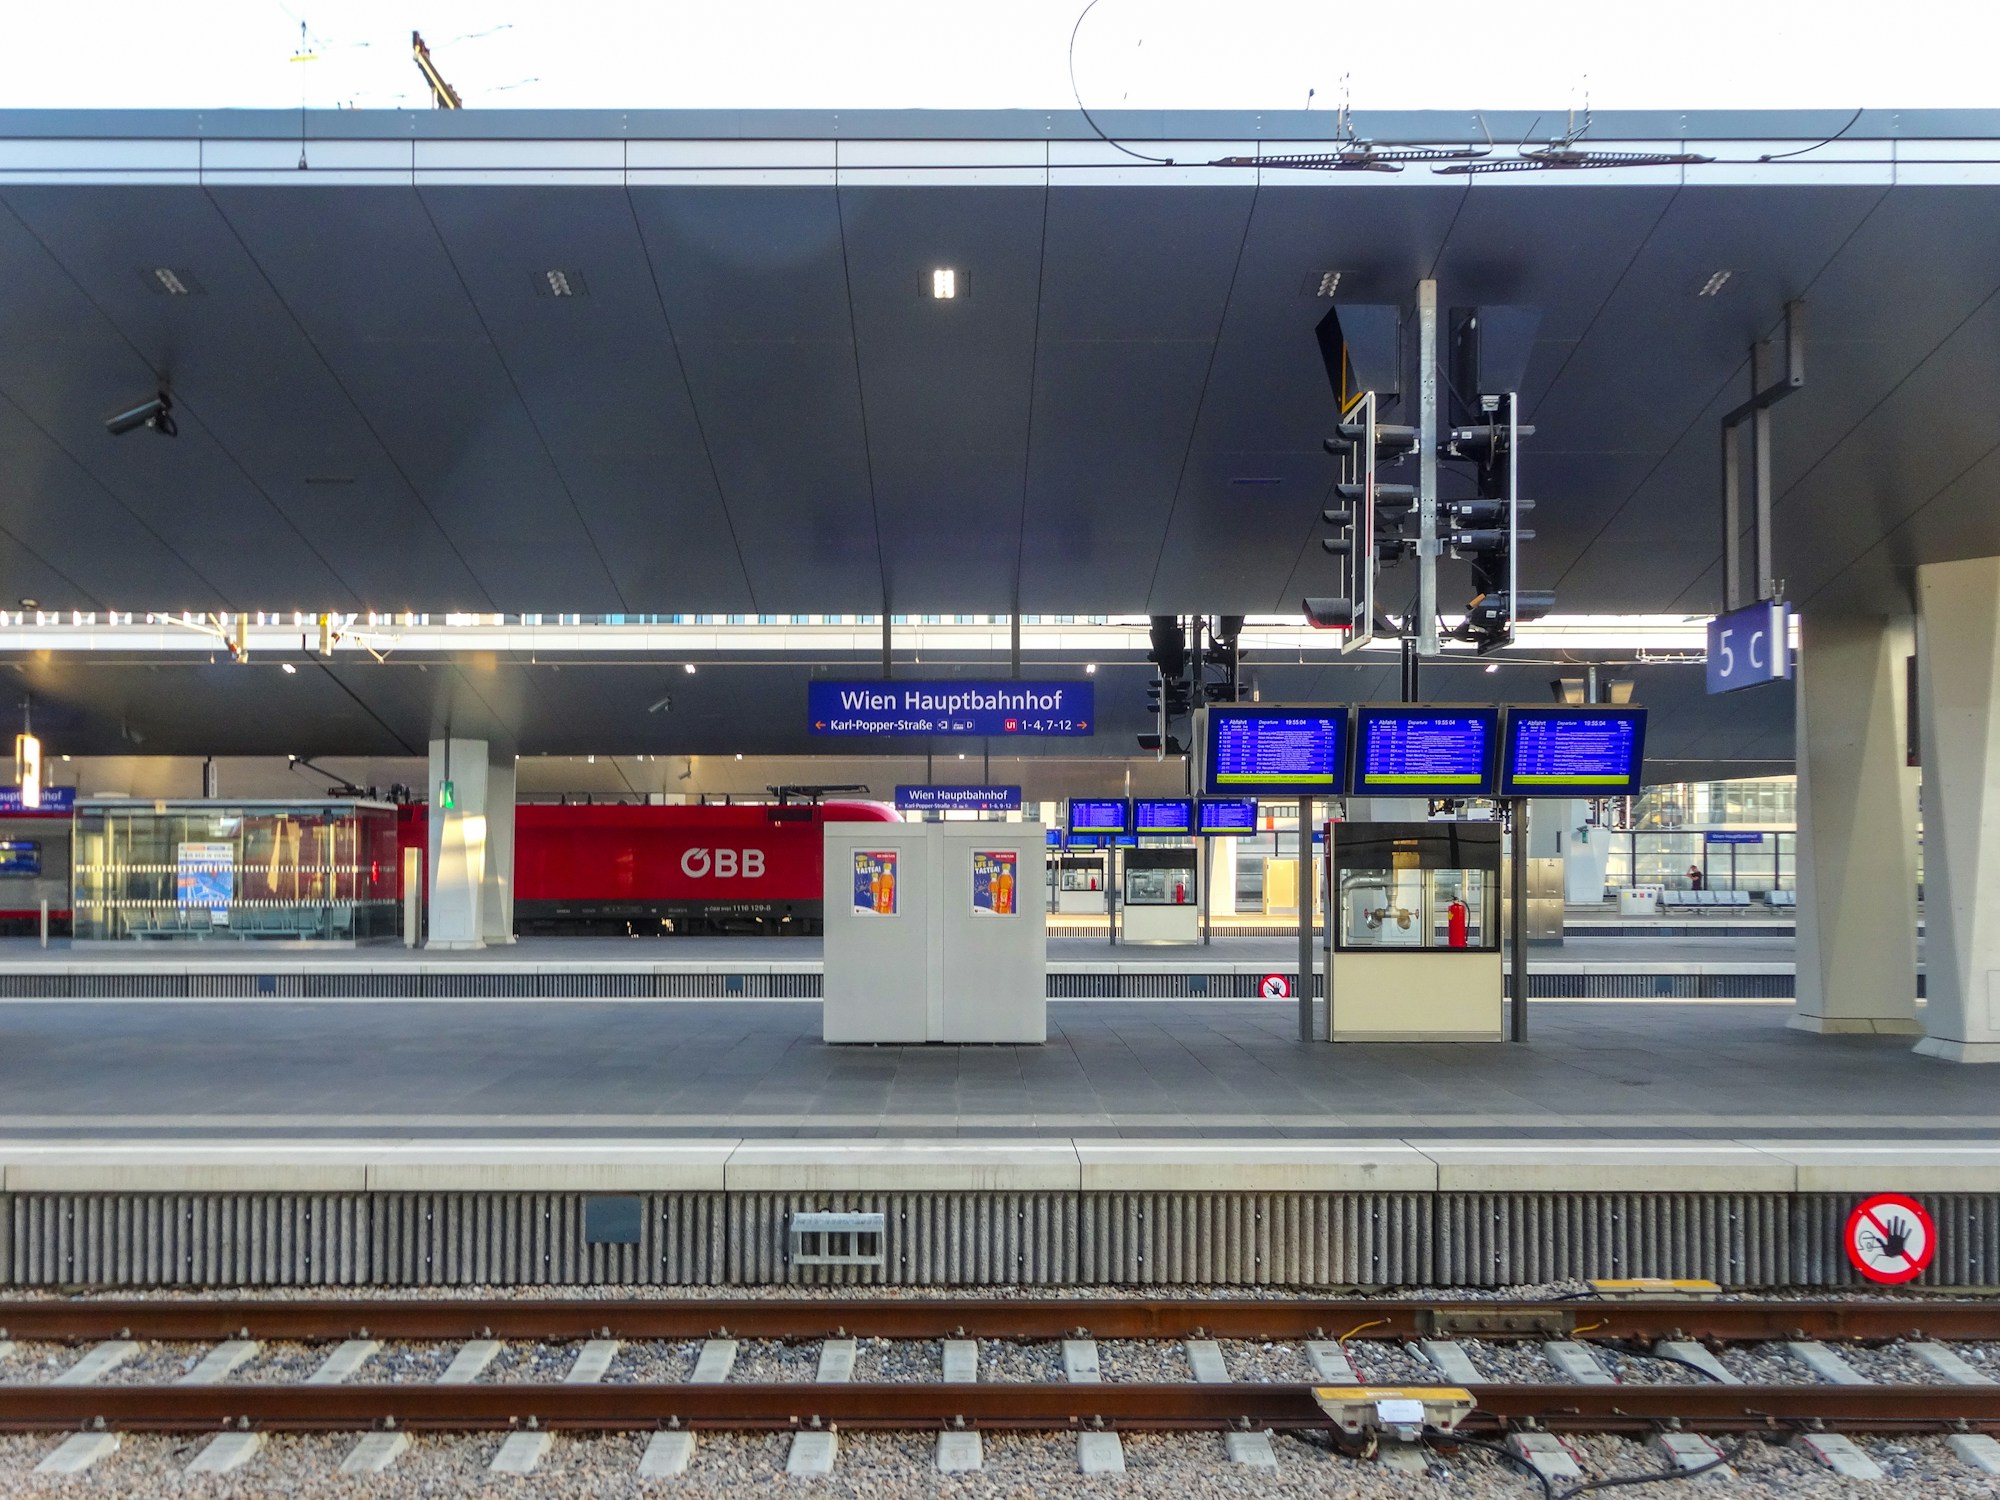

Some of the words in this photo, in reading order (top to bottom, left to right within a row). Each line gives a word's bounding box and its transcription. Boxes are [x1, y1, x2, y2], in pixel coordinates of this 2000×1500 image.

[1720, 629, 1734, 677] 5
[1749, 631, 1763, 668] C
[841, 690, 897, 710] Wien
[905, 690, 1062, 715] Hauptbahnhof
[830, 719, 933, 732] Karl-Popper-Straße
[1006, 721, 1016, 729] U1
[1047, 719, 1072, 730] 7-12
[909, 790, 934, 800] Wien
[937, 790, 1008, 802] Hauptbahnhof
[680, 847, 766, 878] ÖBB
